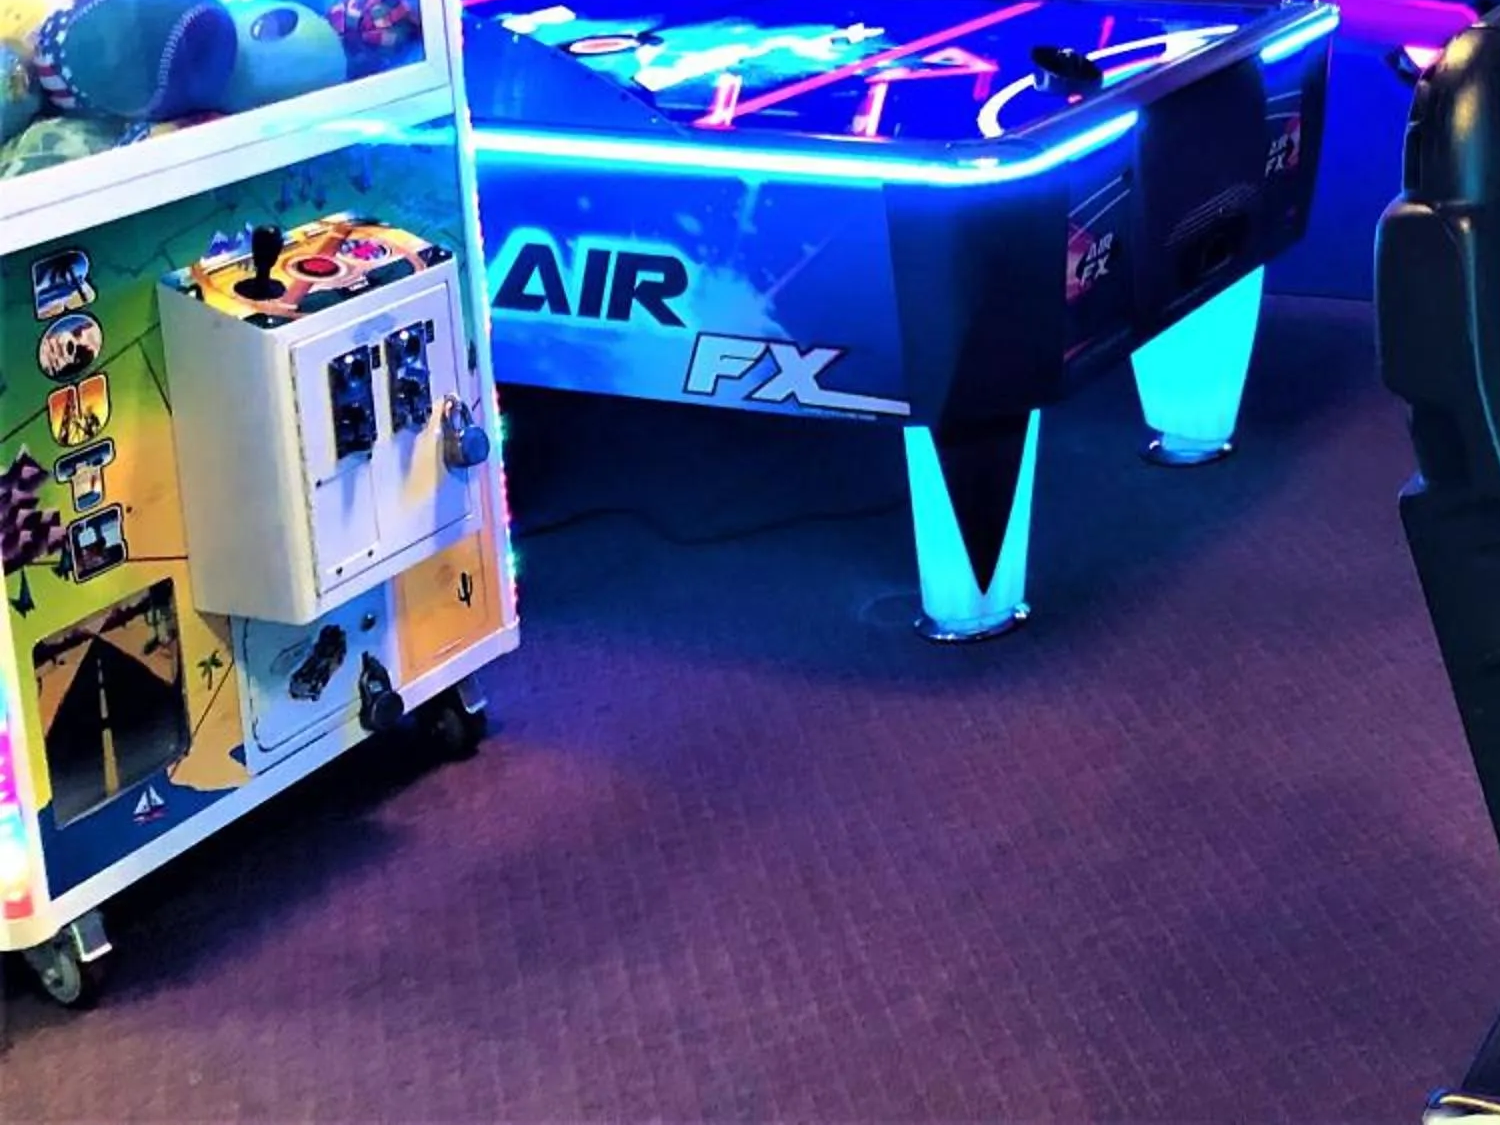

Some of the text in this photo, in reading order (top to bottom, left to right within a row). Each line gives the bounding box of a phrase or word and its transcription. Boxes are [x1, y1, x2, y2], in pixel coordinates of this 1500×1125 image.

[492, 241, 690, 328] AIR
[1080, 254, 1110, 287] FX
[682, 330, 912, 416] FX
